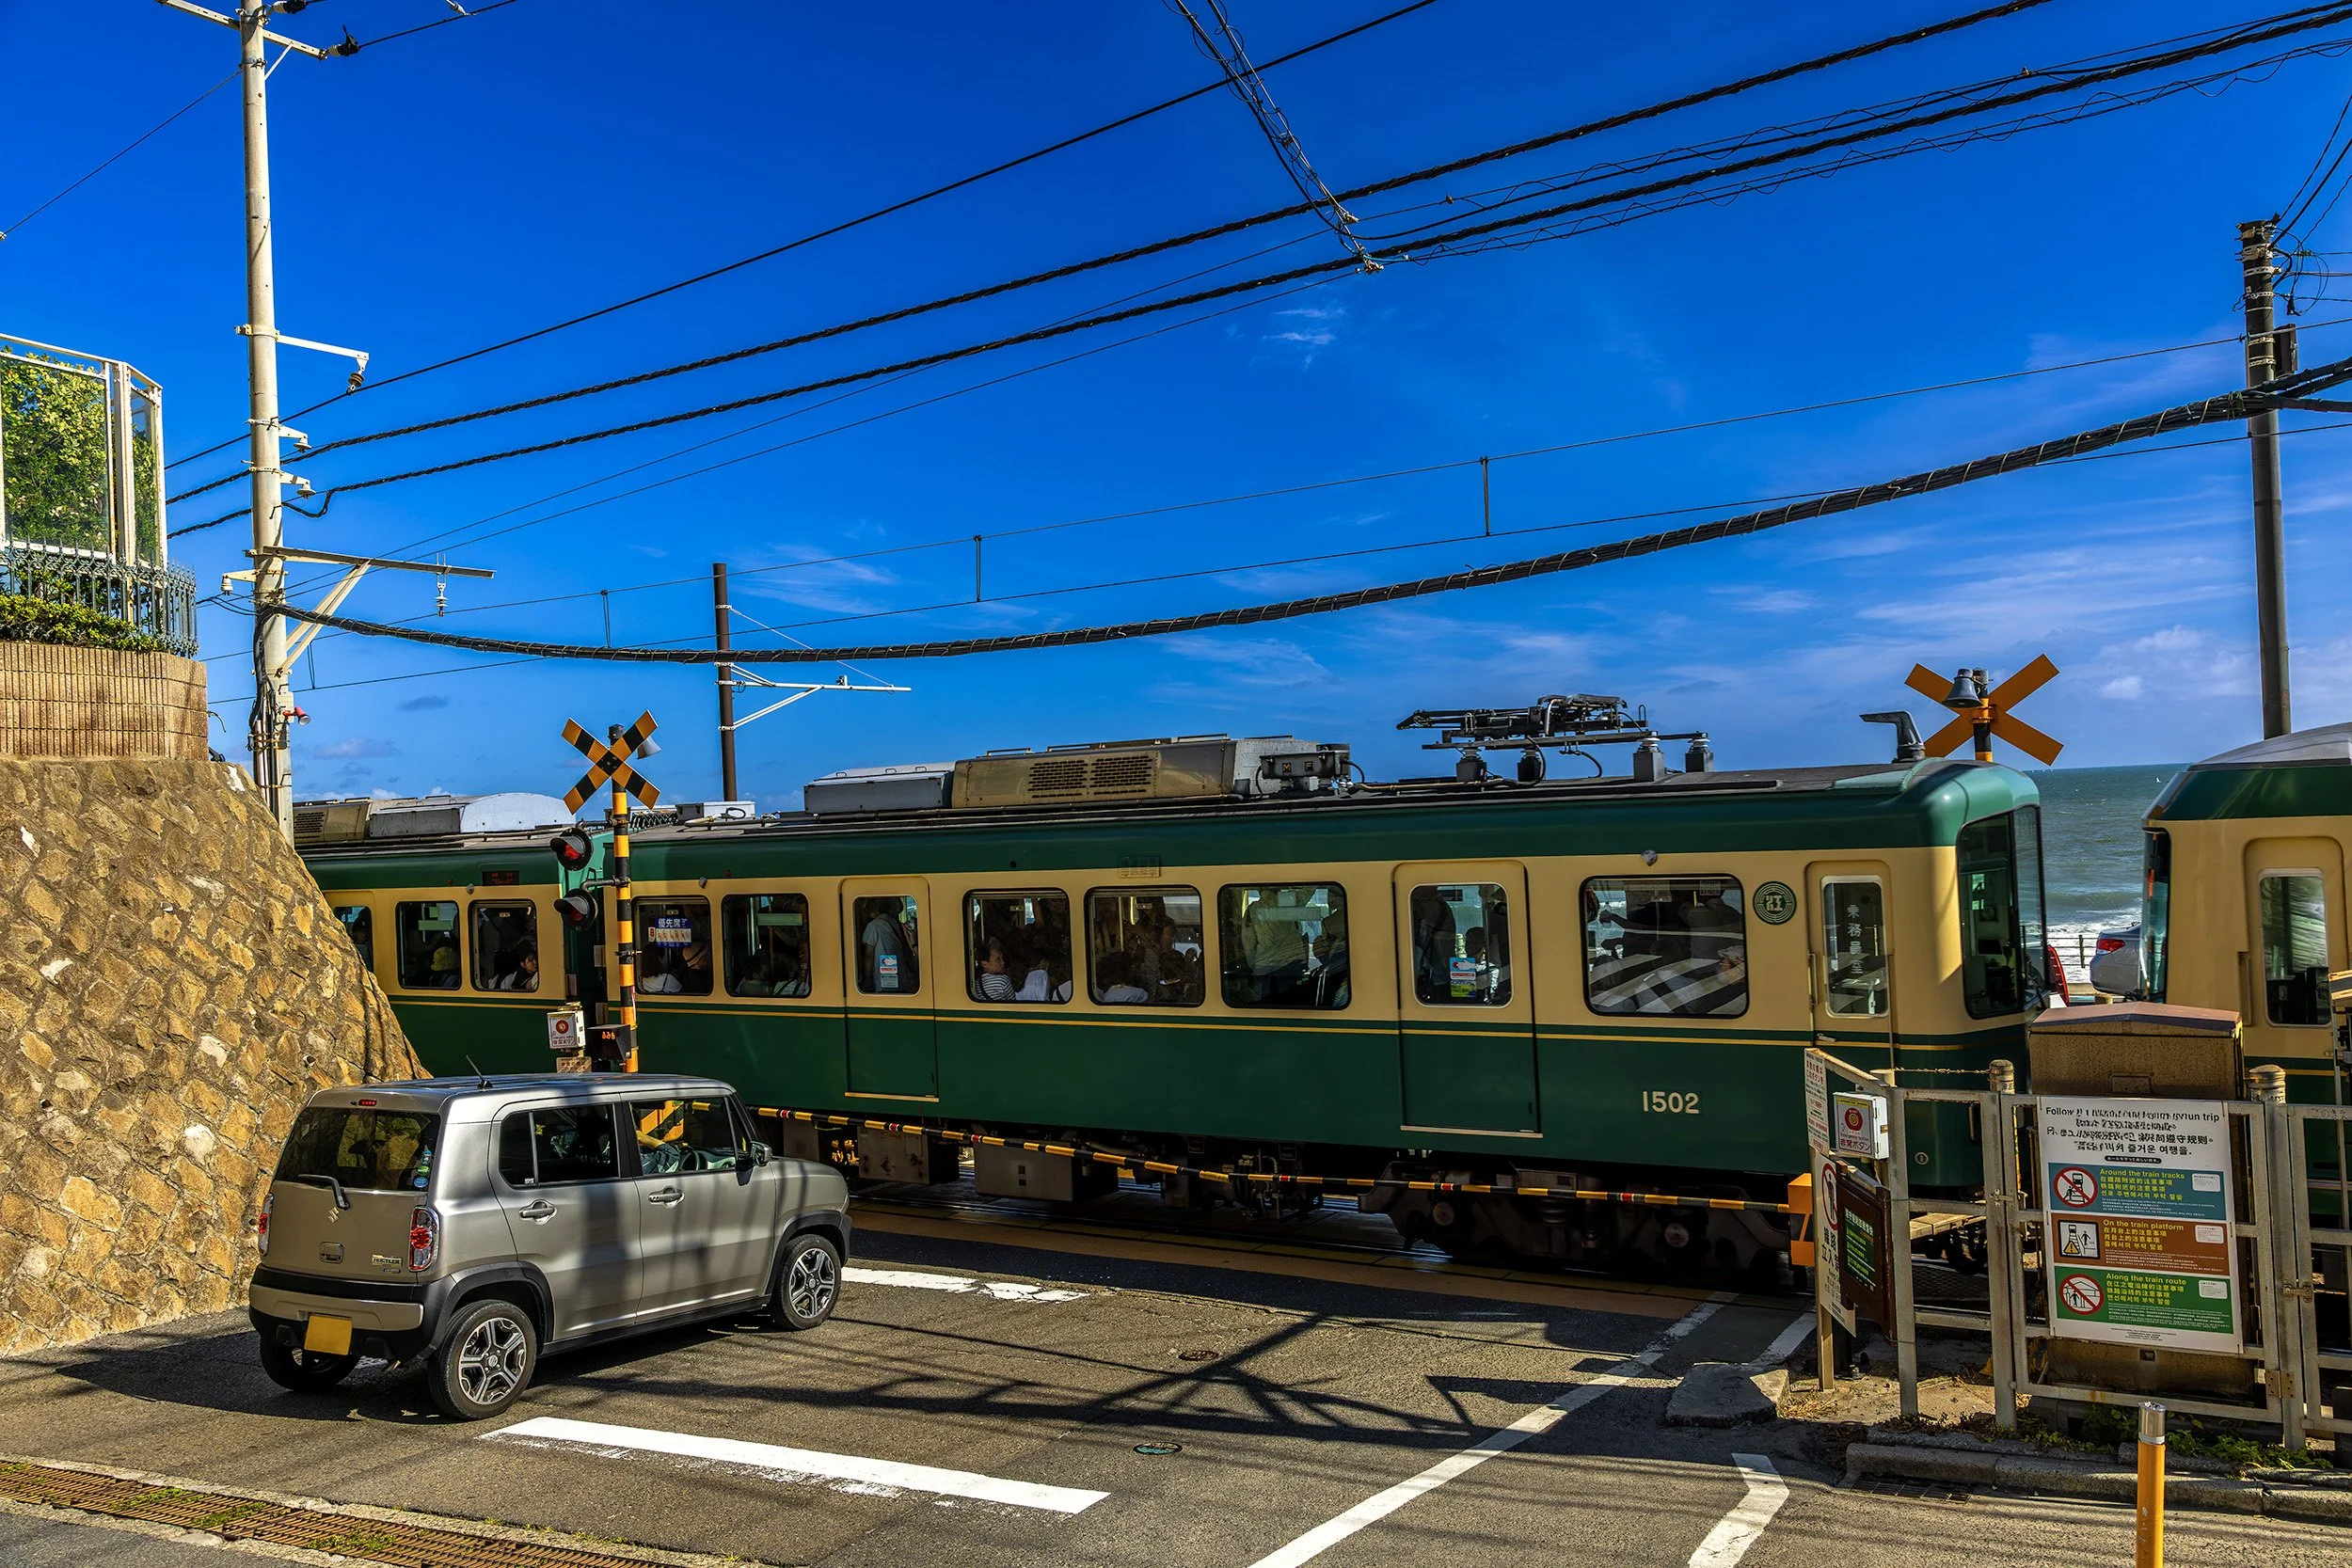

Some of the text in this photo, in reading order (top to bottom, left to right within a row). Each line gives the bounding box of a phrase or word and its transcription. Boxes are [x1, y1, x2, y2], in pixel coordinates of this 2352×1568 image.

[1643, 1090, 1700, 1114] 1502
[2045, 1106, 2074, 1117] Follow
[2202, 1113, 2220, 1123] trip
[2151, 1222, 2185, 1230] platform
[2106, 1273, 2129, 1282] Along
[2166, 1277, 2186, 1286] route
